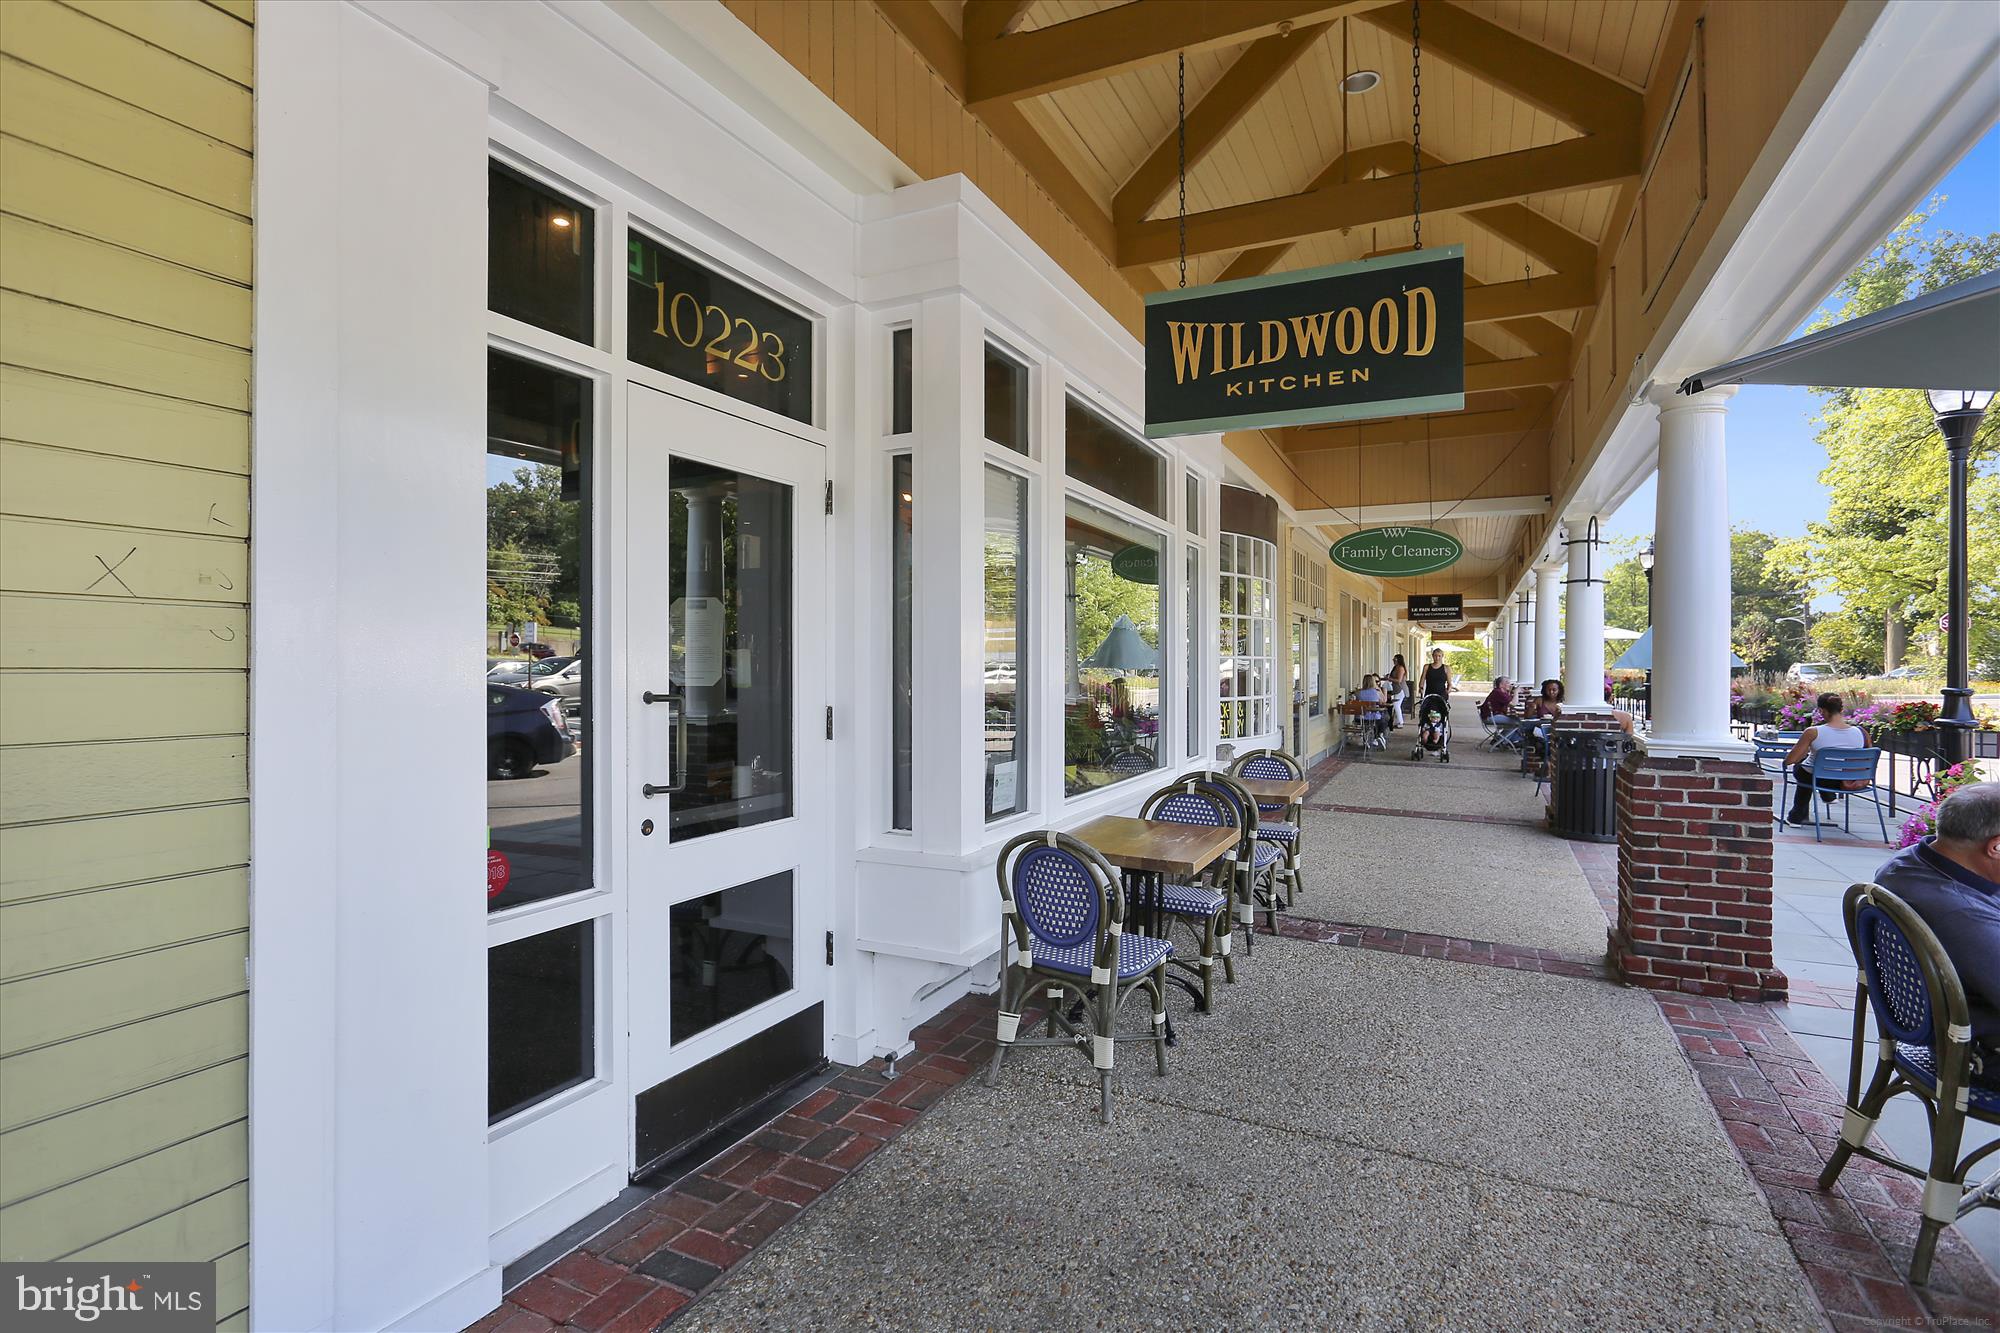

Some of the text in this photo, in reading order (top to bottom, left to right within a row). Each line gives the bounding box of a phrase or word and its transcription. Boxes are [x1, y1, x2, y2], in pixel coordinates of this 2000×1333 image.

[652, 281, 786, 382] 10223
[1166, 286, 1437, 385] WILDWOOD
[1226, 367, 1370, 397] KITCHEN
[1341, 544, 1452, 561] Family Cleaners
